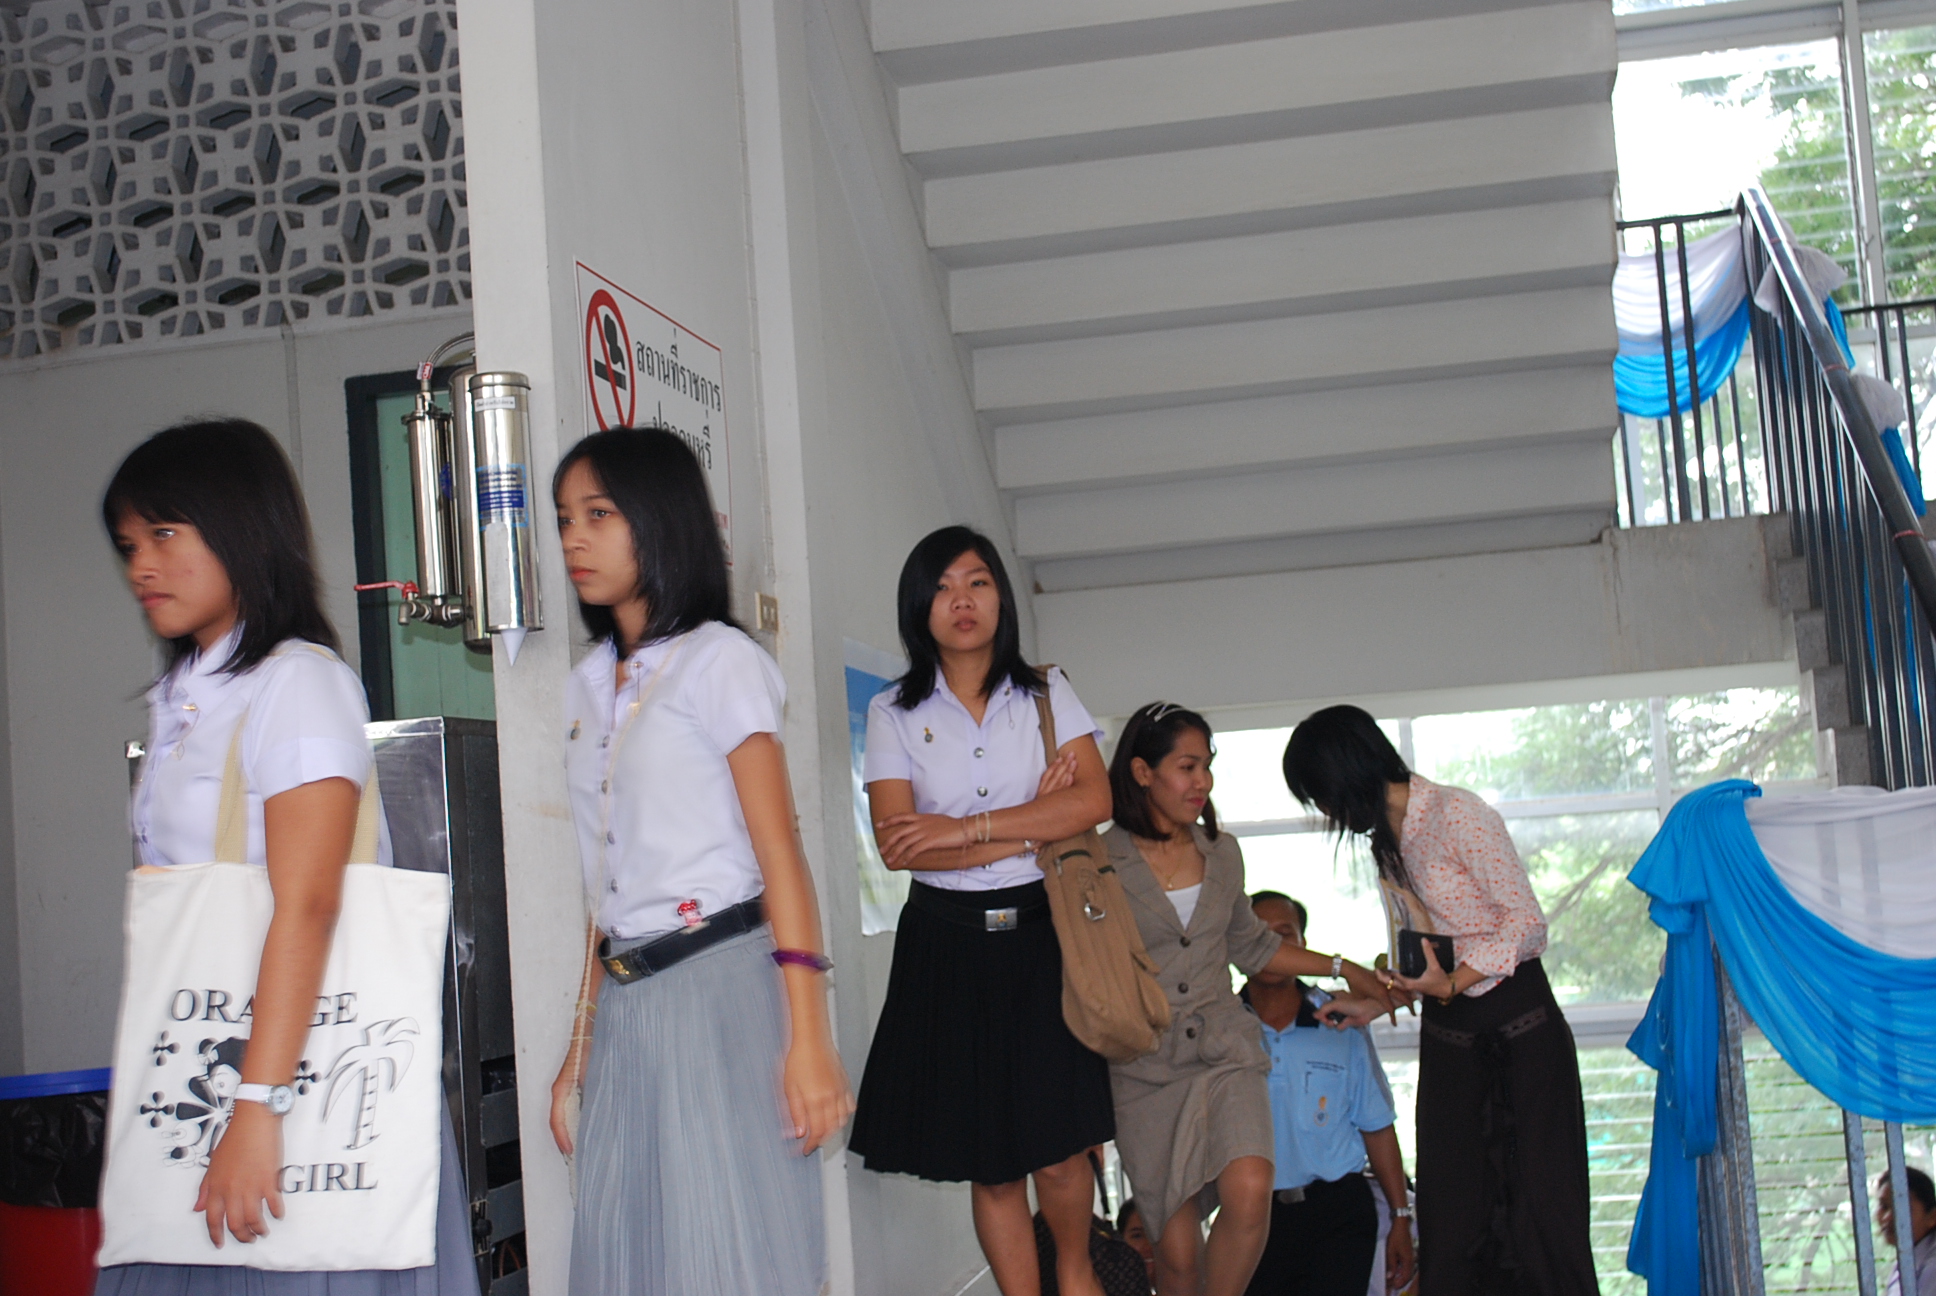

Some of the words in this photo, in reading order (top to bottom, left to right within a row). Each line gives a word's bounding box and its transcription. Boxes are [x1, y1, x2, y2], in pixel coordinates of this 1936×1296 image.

[636, 327, 721, 412] สถานที่ราชการ
[171, 988, 358, 1028] ORAGE
[277, 1162, 378, 1194] GIRL
